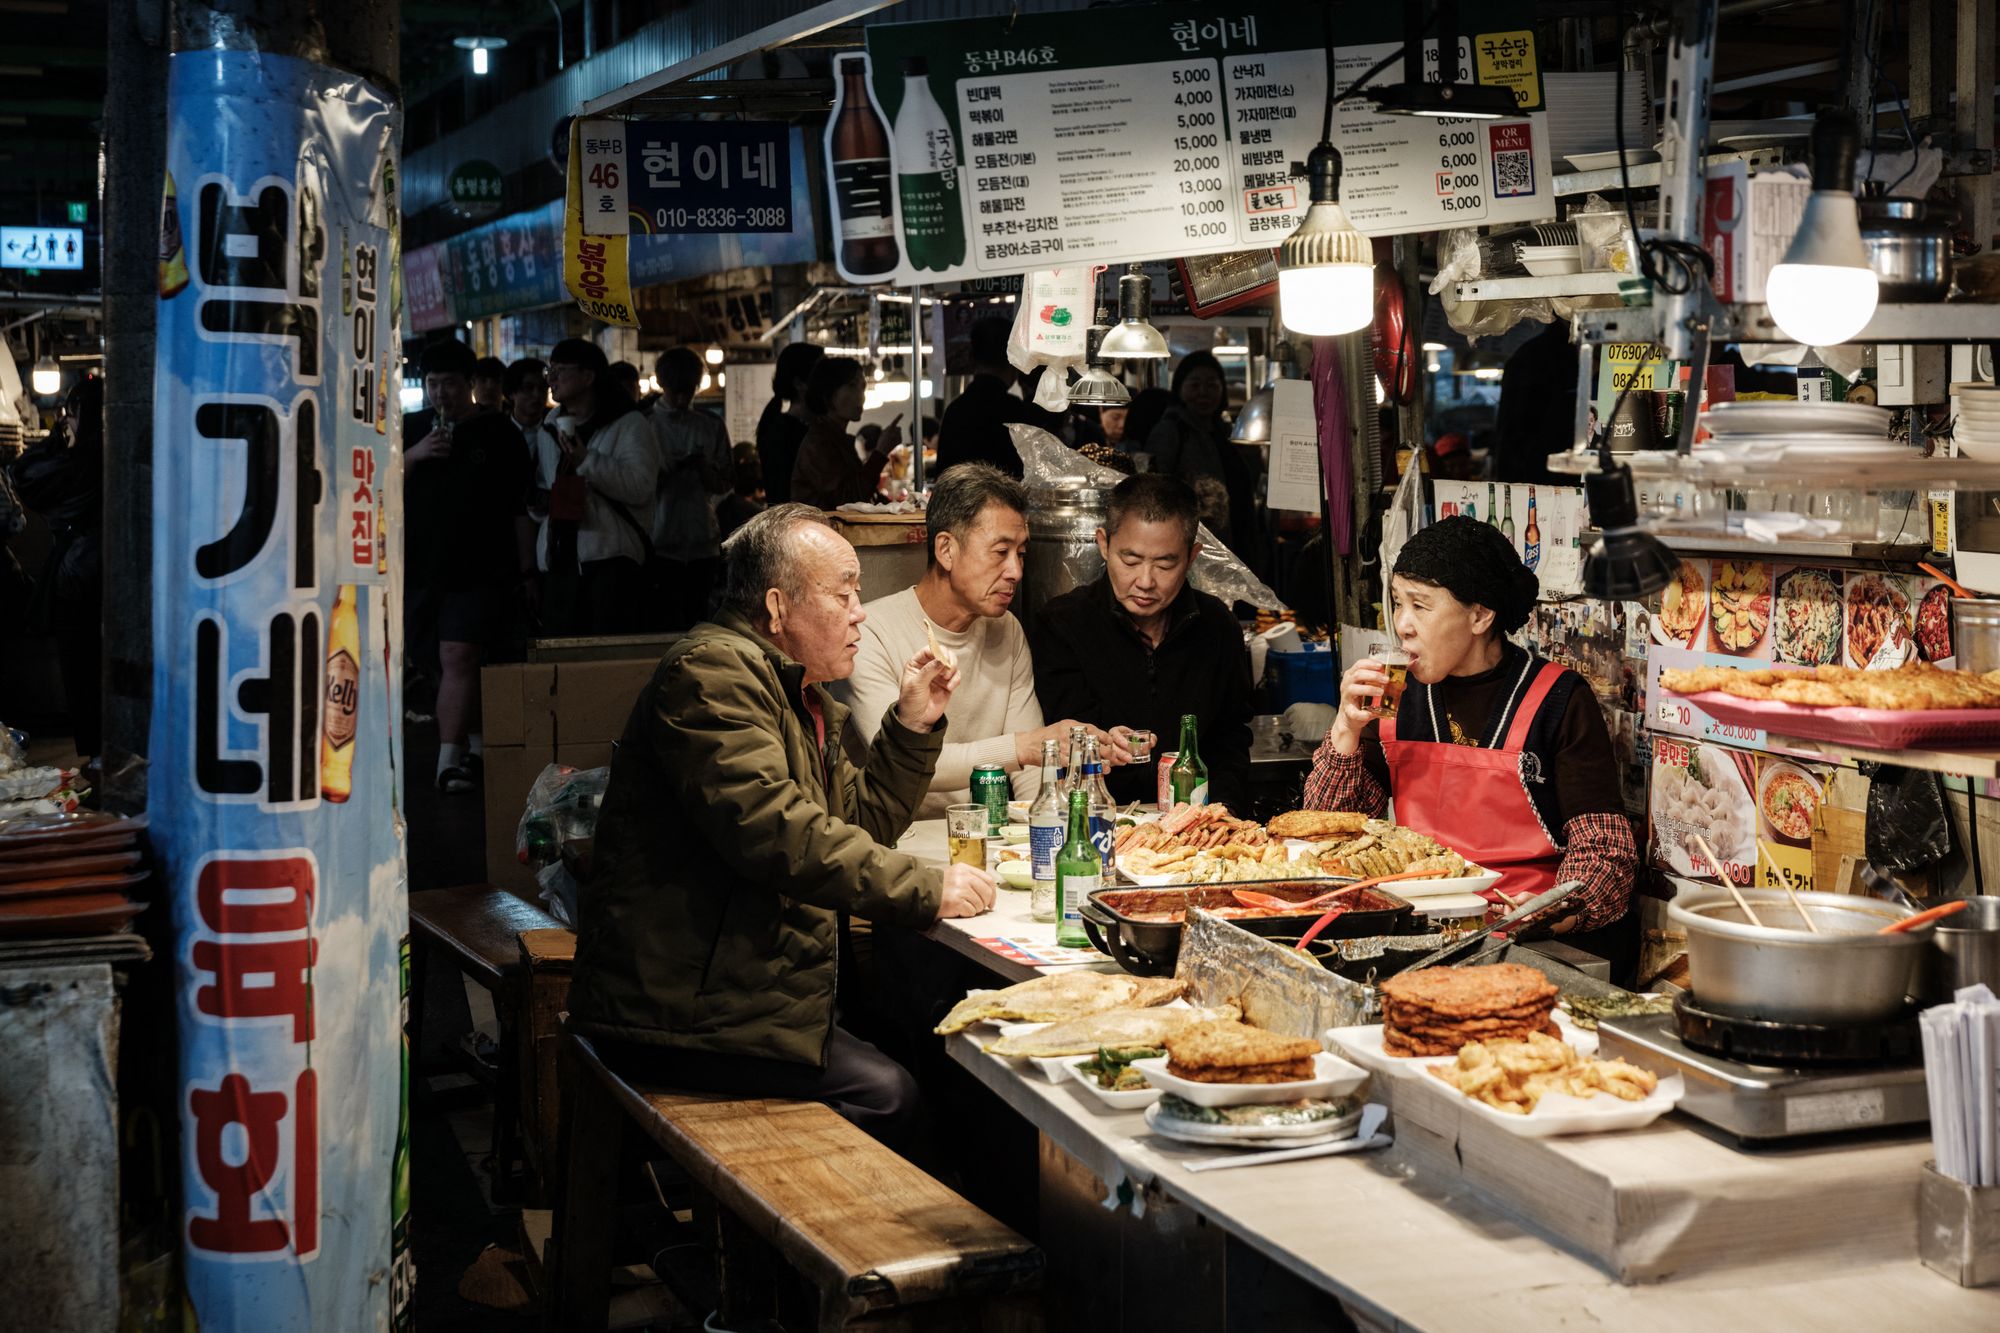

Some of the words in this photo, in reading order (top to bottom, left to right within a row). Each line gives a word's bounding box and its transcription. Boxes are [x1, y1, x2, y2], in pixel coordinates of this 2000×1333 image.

[1172, 15, 1258, 52] 현이네
[1482, 38, 1529, 59] 국순당
[964, 46, 1058, 73] 동부B46호
[1172, 67, 1211, 85] 5,000
[1232, 63, 1266, 79] 산낙지
[966, 86, 1001, 102] 빈대떡
[1174, 89, 1213, 107] 4,000
[1235, 84, 1295, 101] 가자미전(소)
[969, 108, 1004, 124] 떡볶이
[1177, 111, 1215, 129] 5,000
[1237, 106, 1297, 123] 가자미전(대)
[971, 129, 1018, 148] 해물라면
[1239, 128, 1272, 144] 물냉면
[1439, 132, 1475, 148] 6,000
[1501, 126, 1518, 139] QR
[586, 138, 623, 155] 동부B
[1173, 133, 1218, 151] 15,000
[1495, 136, 1527, 149] MENU
[641, 140, 777, 190] 현이네
[974, 151, 1036, 170] 모듬전(기본)
[1173, 155, 1220, 173] 20,000
[1241, 149, 1285, 166] 비빔냉면
[1441, 152, 1477, 168] 6,000
[589, 162, 619, 190] 46
[977, 173, 1029, 192] 모듬전(대)
[1178, 177, 1222, 195] 13,000
[598, 195, 616, 213] 호
[980, 196, 1025, 214] 해물파전
[1181, 199, 1225, 217] 10,000
[1441, 194, 1482, 212] 15,000
[656, 206, 786, 228] 010-8336-3088
[982, 216, 1058, 236] 부추전+김치전
[1184, 221, 1228, 239] 15,000
[985, 238, 1064, 260] 꼼장어소금구이
[353, 245, 376, 424] 현이네
[352, 448, 375, 566] 맛집
[1723, 724, 1757, 741] 20,000
[1678, 820, 1711, 841] dumpling
[189, 857, 319, 1256] 육회
